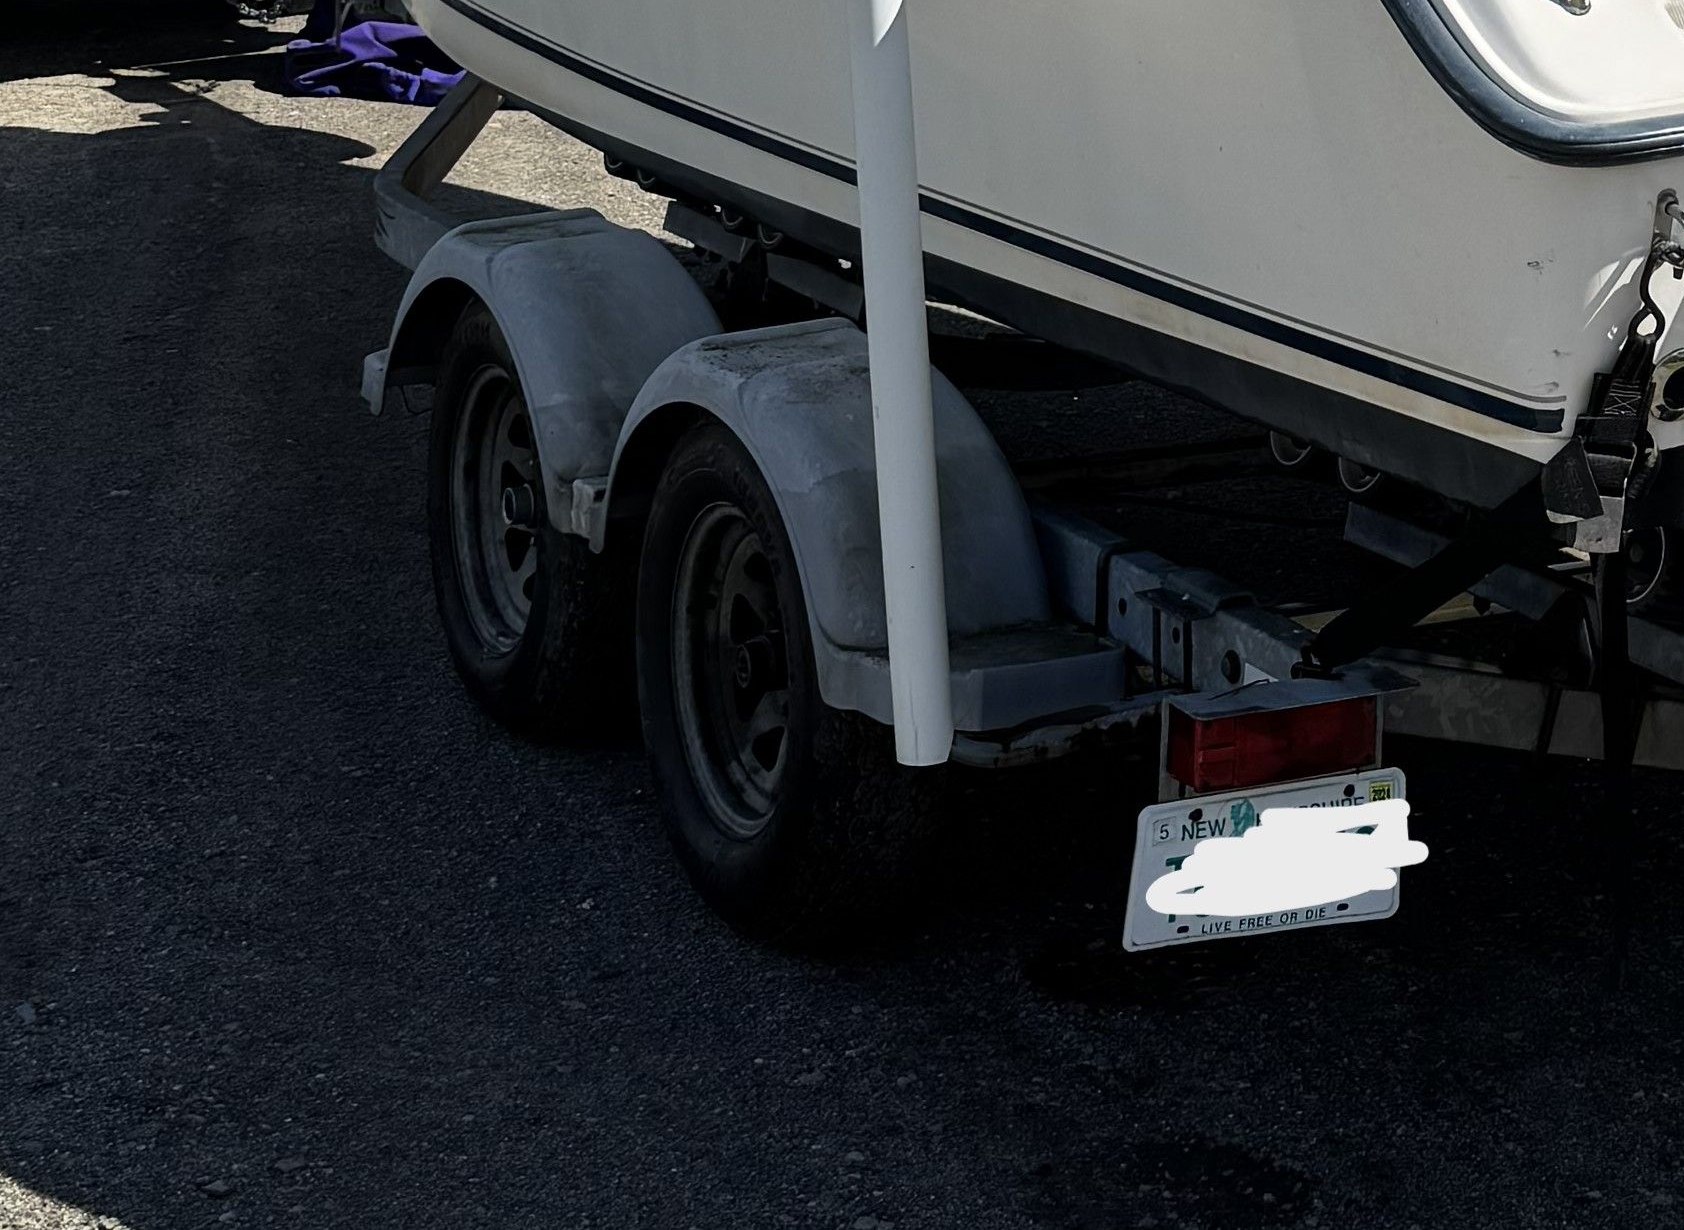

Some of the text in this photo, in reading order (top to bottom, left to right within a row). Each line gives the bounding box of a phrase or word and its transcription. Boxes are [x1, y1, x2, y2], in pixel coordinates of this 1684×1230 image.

[1159, 824, 1170, 840] 5
[1180, 817, 1227, 842] NEW
[1201, 907, 1327, 935] LIVE FREE OR DIE
